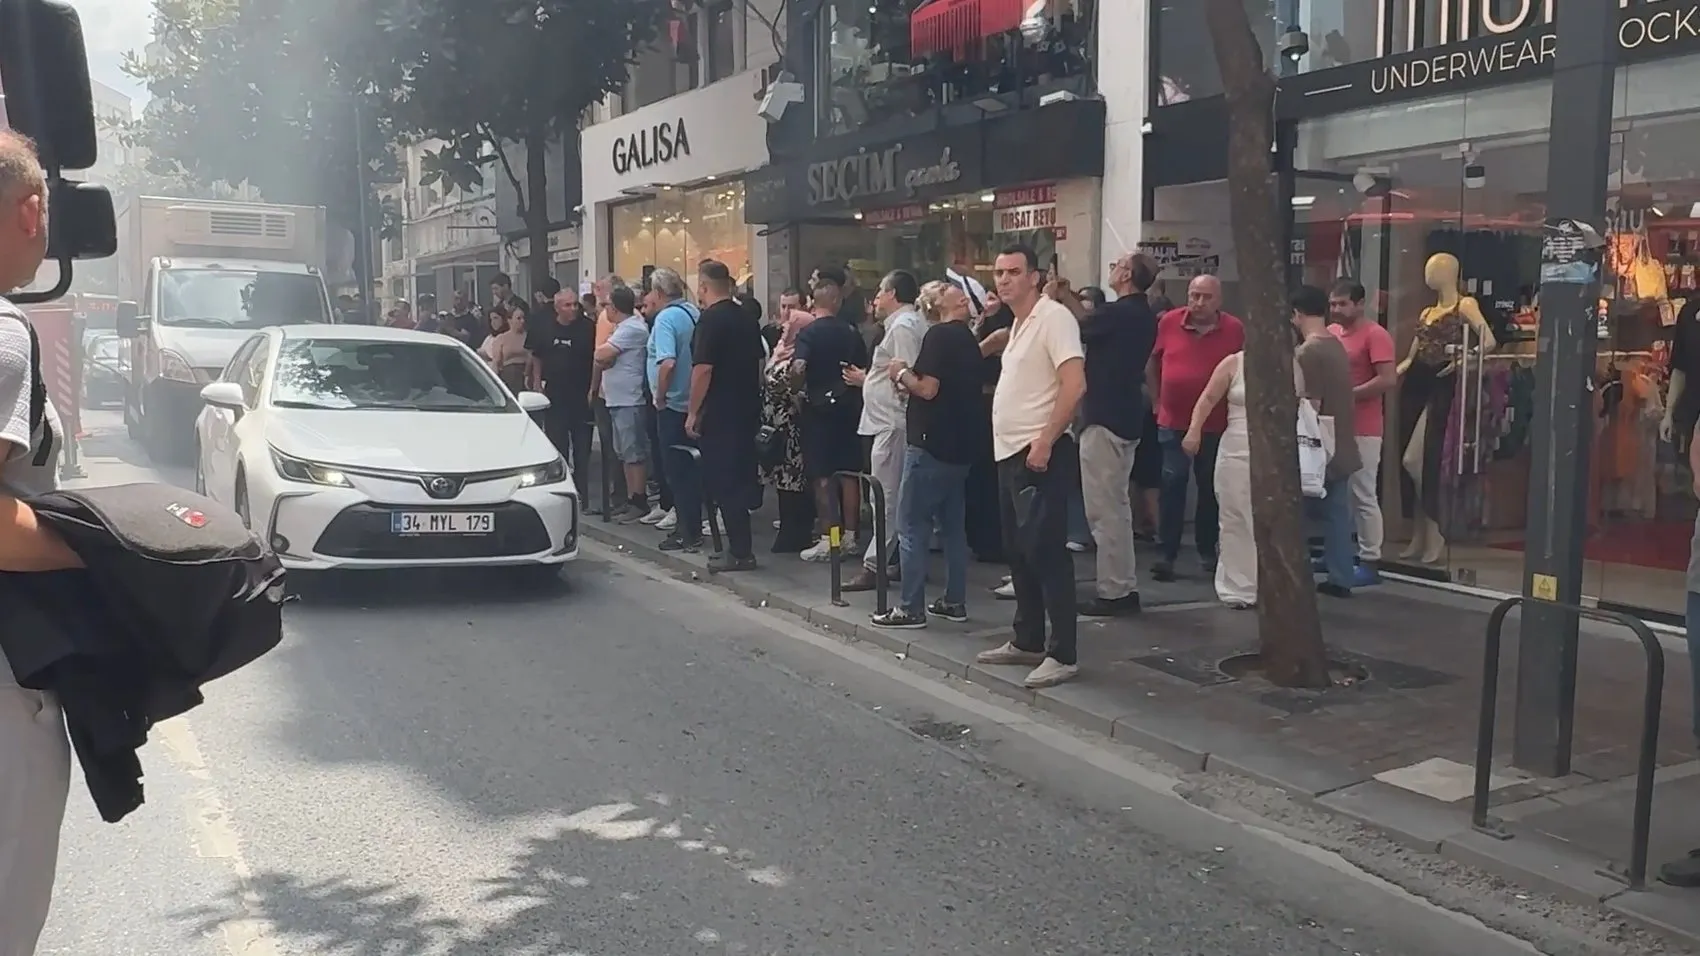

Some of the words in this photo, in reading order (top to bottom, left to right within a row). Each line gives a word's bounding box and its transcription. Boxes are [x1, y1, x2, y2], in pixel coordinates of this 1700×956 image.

[1371, 34, 1556, 93] UNDERWEAR
[612, 117, 690, 174] GALISA
[807, 146, 901, 206] SEÇİM
[403, 514, 420, 531] 34
[430, 514, 456, 531] MYL
[466, 514, 490, 531] 179
